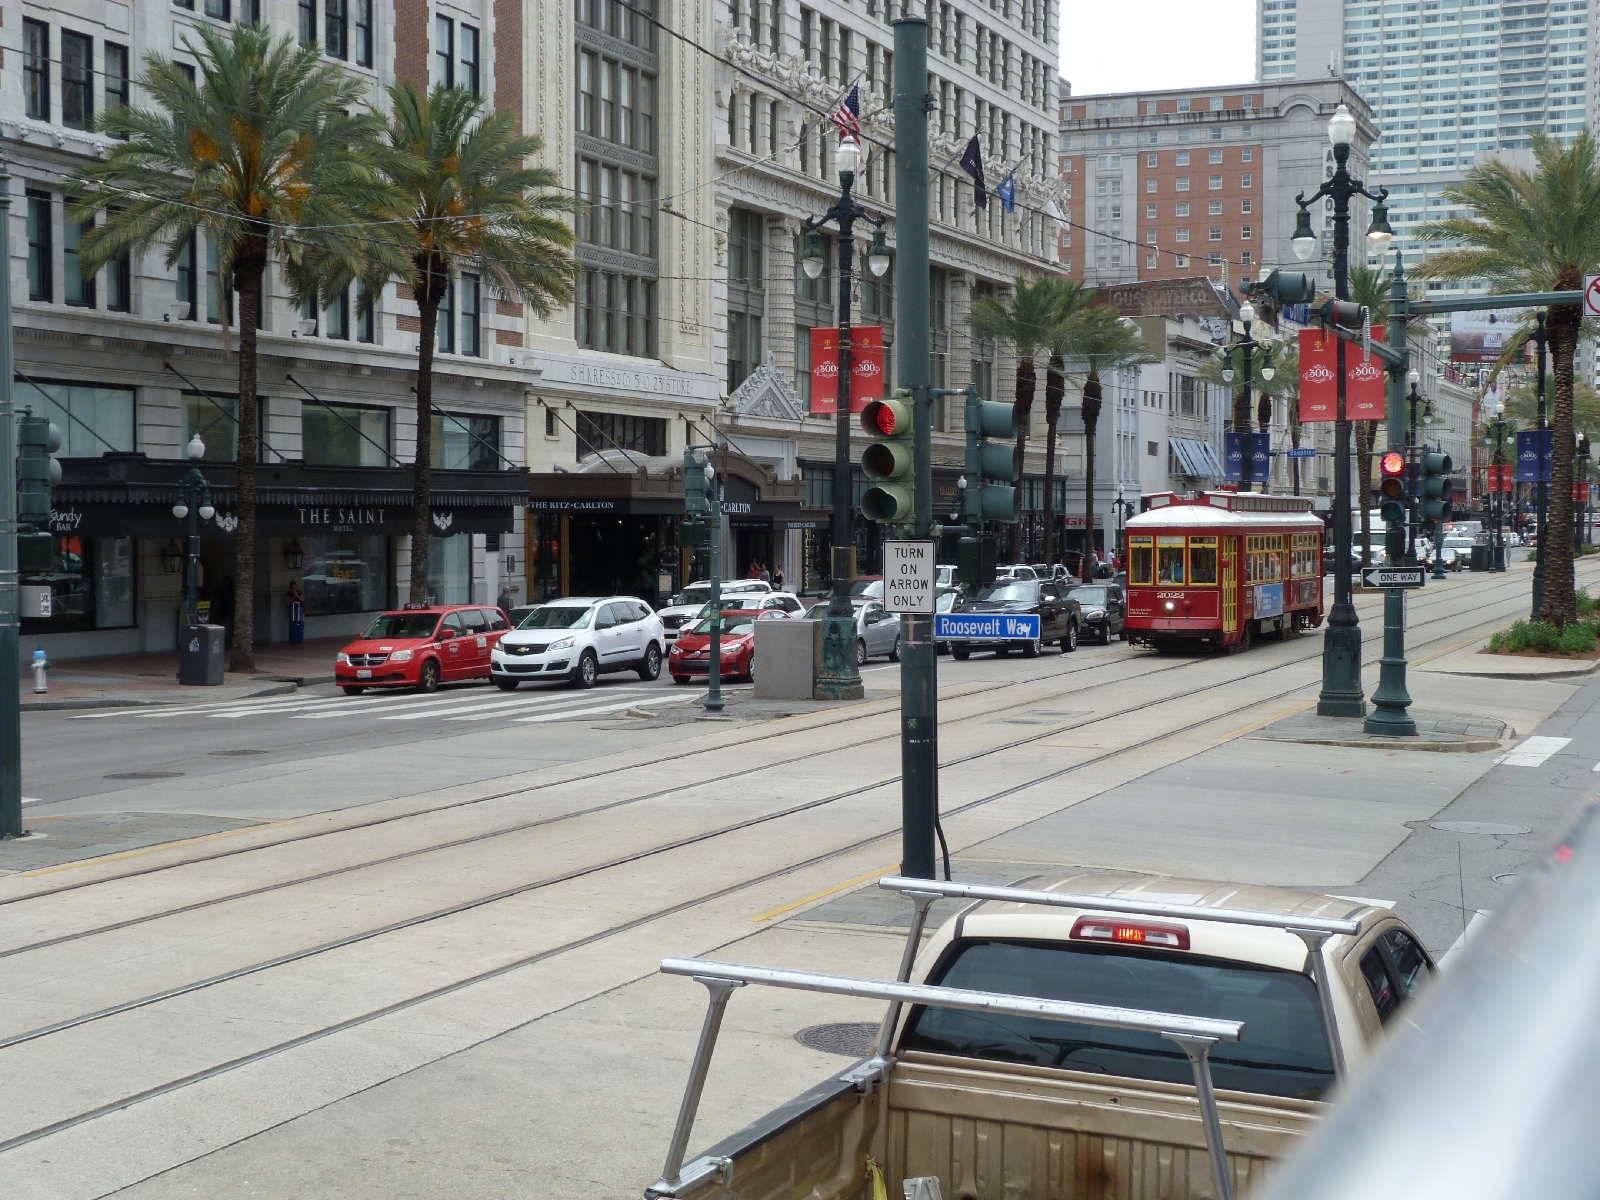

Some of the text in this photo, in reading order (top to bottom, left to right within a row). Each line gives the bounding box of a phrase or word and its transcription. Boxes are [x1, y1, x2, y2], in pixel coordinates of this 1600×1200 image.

[1325, 149, 1334, 228] ASOR
[1289, 449, 1316, 457] Dauphine
[530, 501, 548, 509] THE
[298, 508, 386, 524] THE SAINT
[1065, 517, 1102, 526] GNC
[56, 522, 71, 532] BAR
[894, 547, 924, 559] TURN
[900, 563, 917, 575] ON
[1380, 573, 1418, 582] ONE WAY
[889, 579, 929, 590] ARROW
[1156, 591, 1185, 599] 2022
[893, 595, 924, 607] ONLY
[941, 617, 1032, 638] Roosevelt Way
